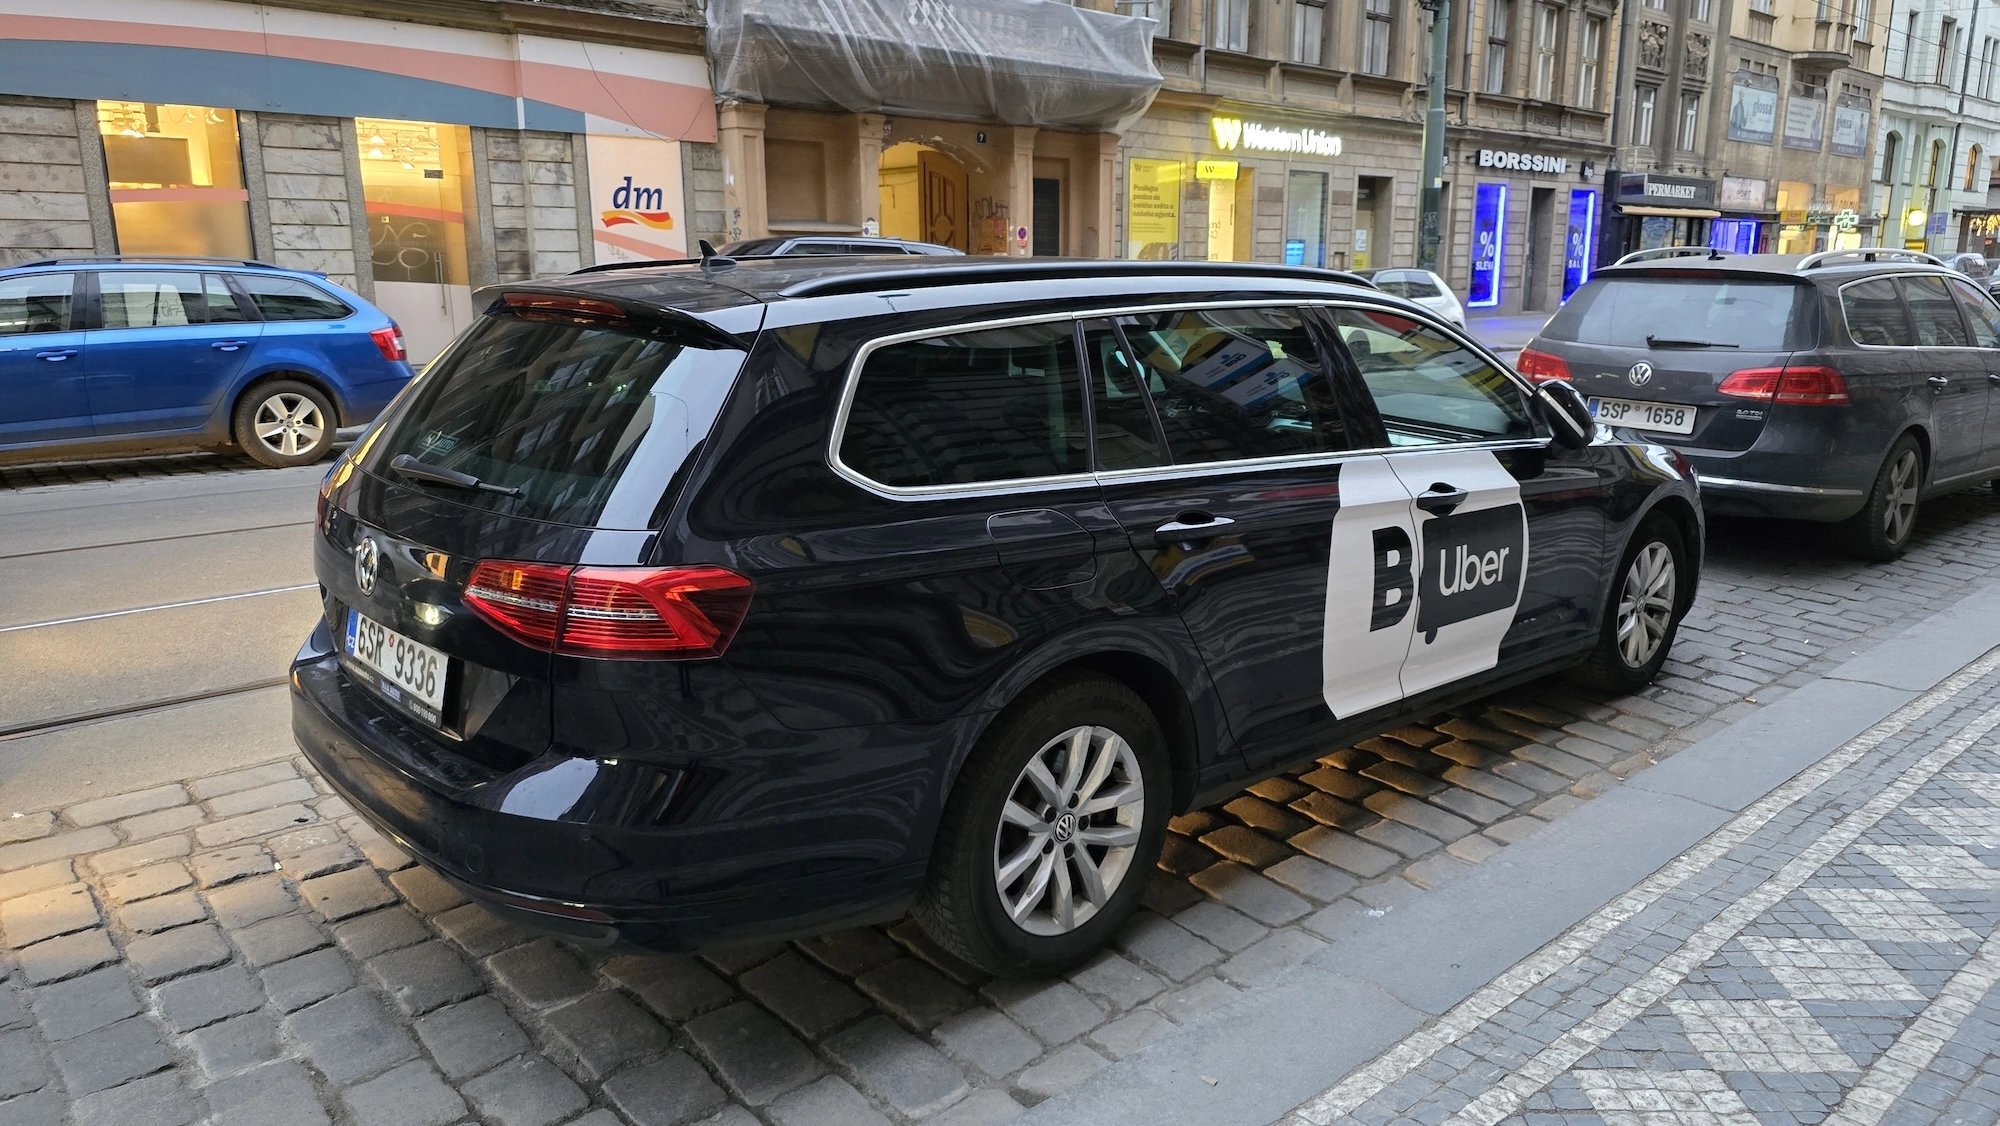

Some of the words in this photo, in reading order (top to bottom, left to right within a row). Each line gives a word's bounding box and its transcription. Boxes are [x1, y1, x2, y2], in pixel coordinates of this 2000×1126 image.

[1242, 122, 1302, 152] Western
[1302, 128, 1342, 157] Union
[1479, 149, 1567, 174] BORSSINI
[612, 176, 663, 210] dm
[1647, 183, 1696, 199] PERMARKET
[1600, 402, 1631, 420] 5SP
[1644, 405, 1685, 426] 1658
[1369, 525, 1415, 633] B
[1439, 544, 1510, 597] Uber
[358, 616, 385, 668] 6SR
[394, 638, 438, 698] 9336
